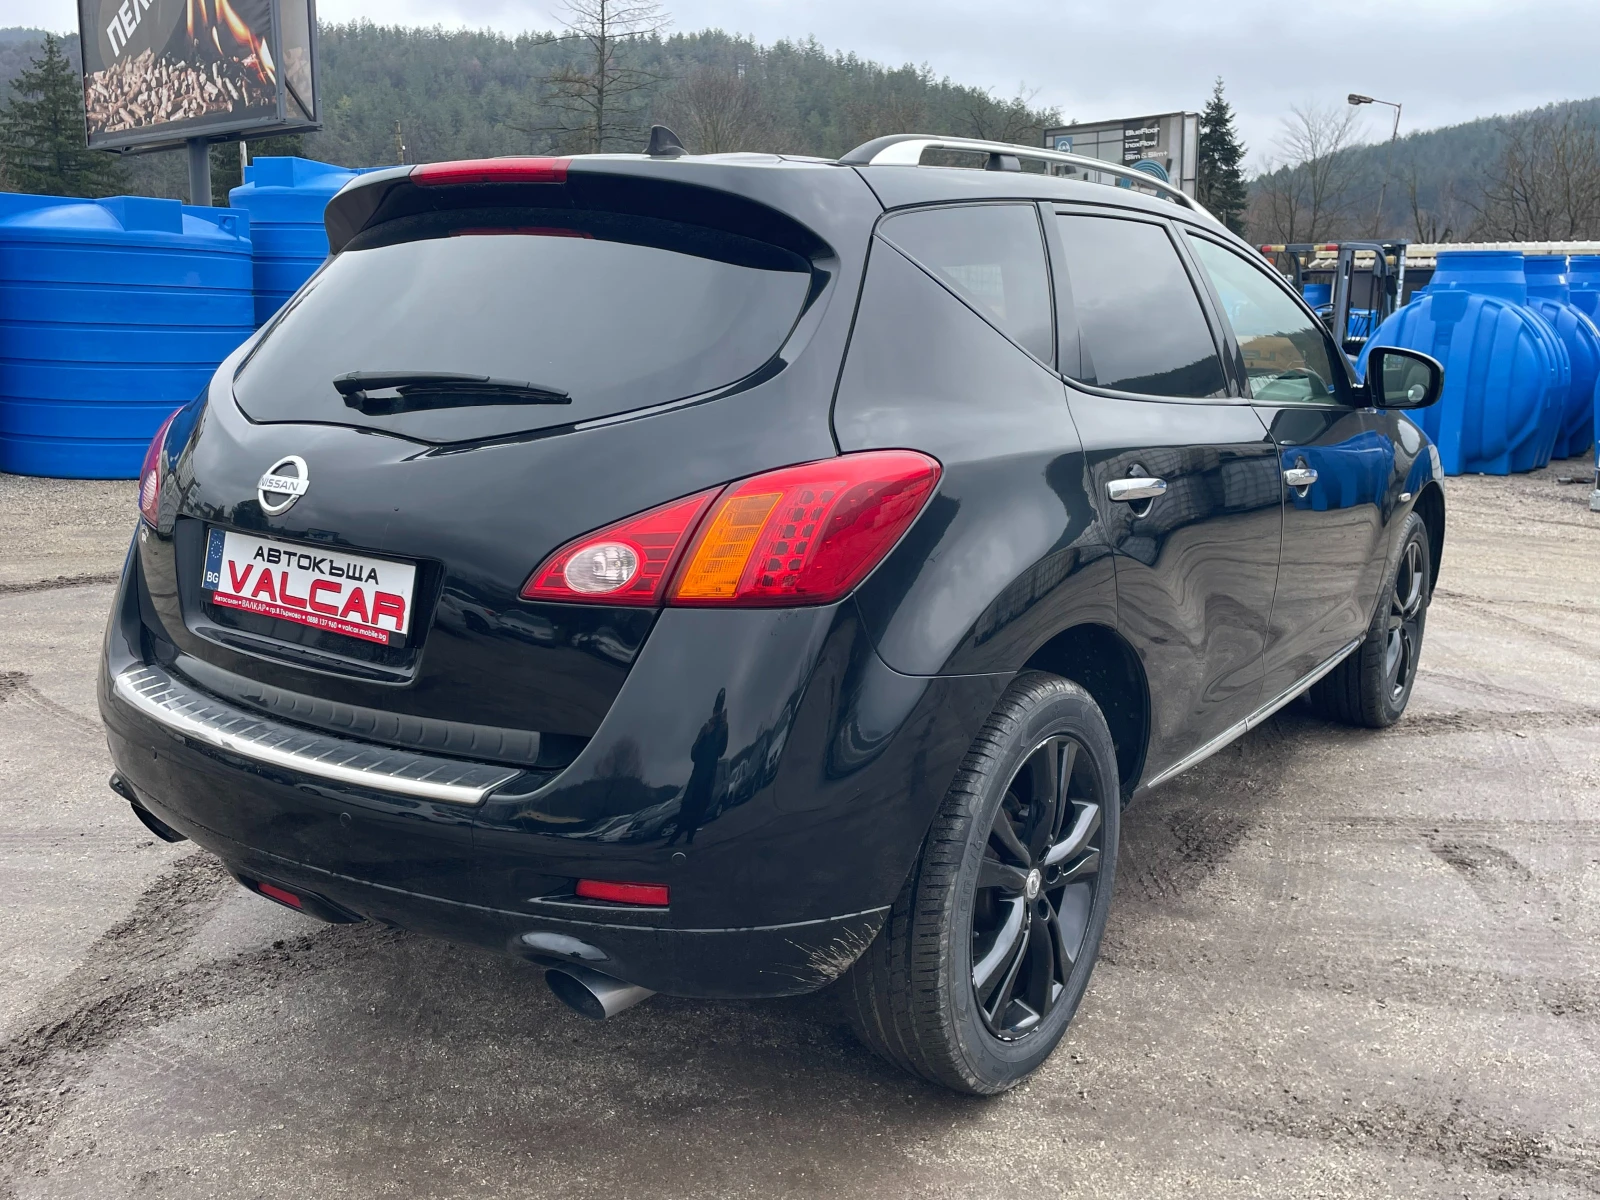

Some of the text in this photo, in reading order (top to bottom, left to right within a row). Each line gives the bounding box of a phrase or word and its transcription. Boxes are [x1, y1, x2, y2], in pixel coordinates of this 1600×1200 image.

[106, 0, 153, 57] ПЕЛ
[1124, 153, 1141, 161] Slim
[260, 477, 300, 491] NISSAN
[206, 571, 219, 584] BG
[253, 545, 379, 585] АВТОКЪША
[228, 560, 406, 631] VALCAR
[241, 599, 267, 612] ВАЛКАР
[319, 618, 328, 627] 137
[328, 620, 338, 629] 960
[342, 624, 387, 642] valcar.mobile.bg
